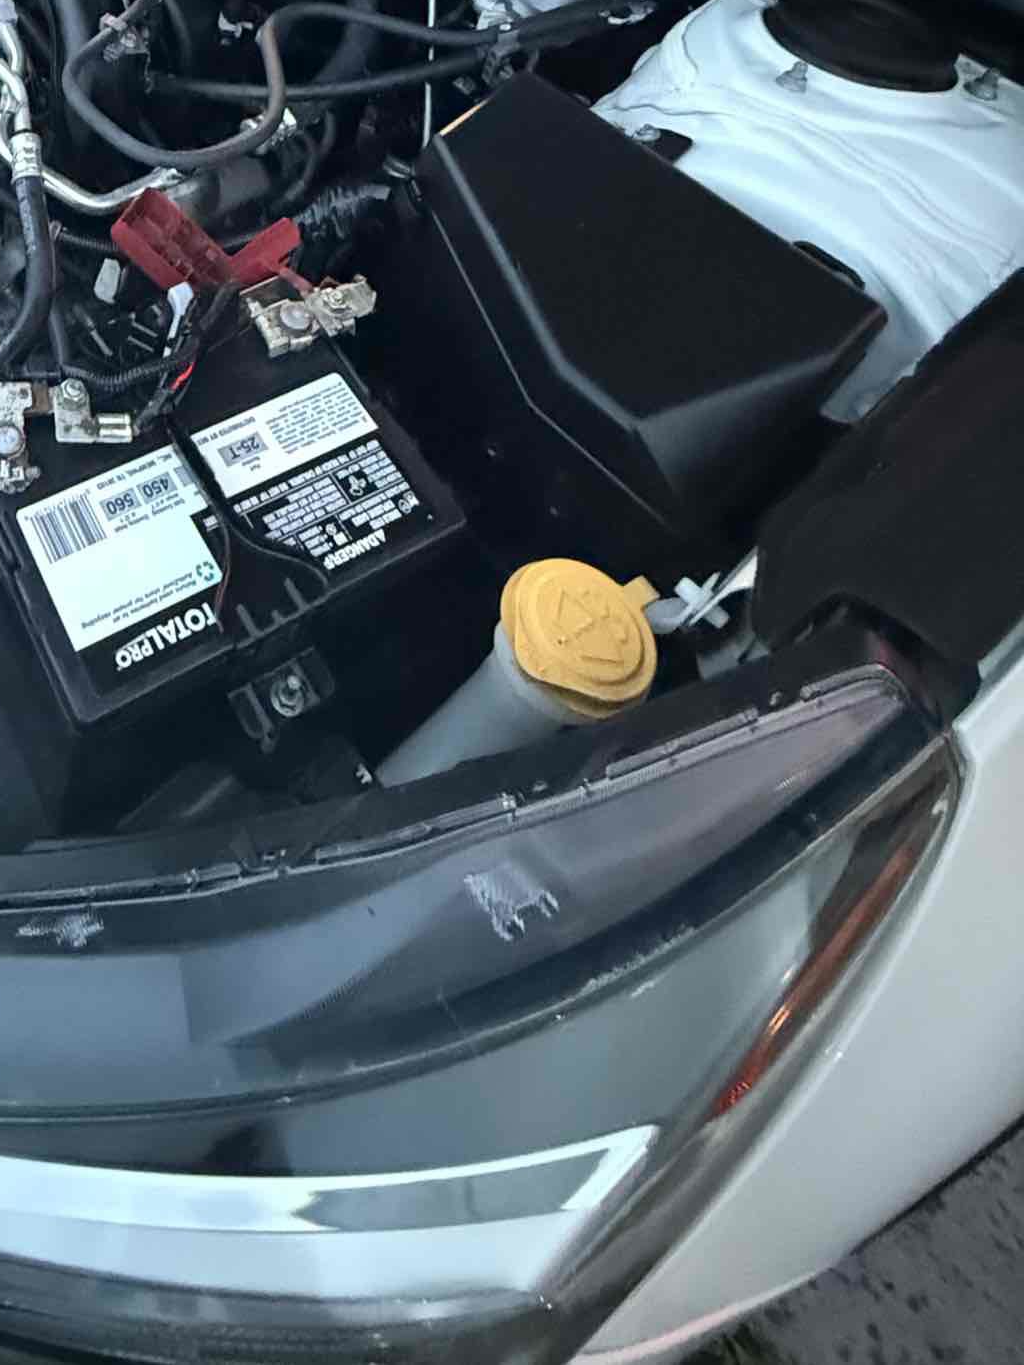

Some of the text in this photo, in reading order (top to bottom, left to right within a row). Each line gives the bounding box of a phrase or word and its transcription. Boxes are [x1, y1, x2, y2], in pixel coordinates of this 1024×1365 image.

[227, 435, 260, 460] 25-T
[140, 475, 172, 500] 450
[104, 491, 135, 516] 560
